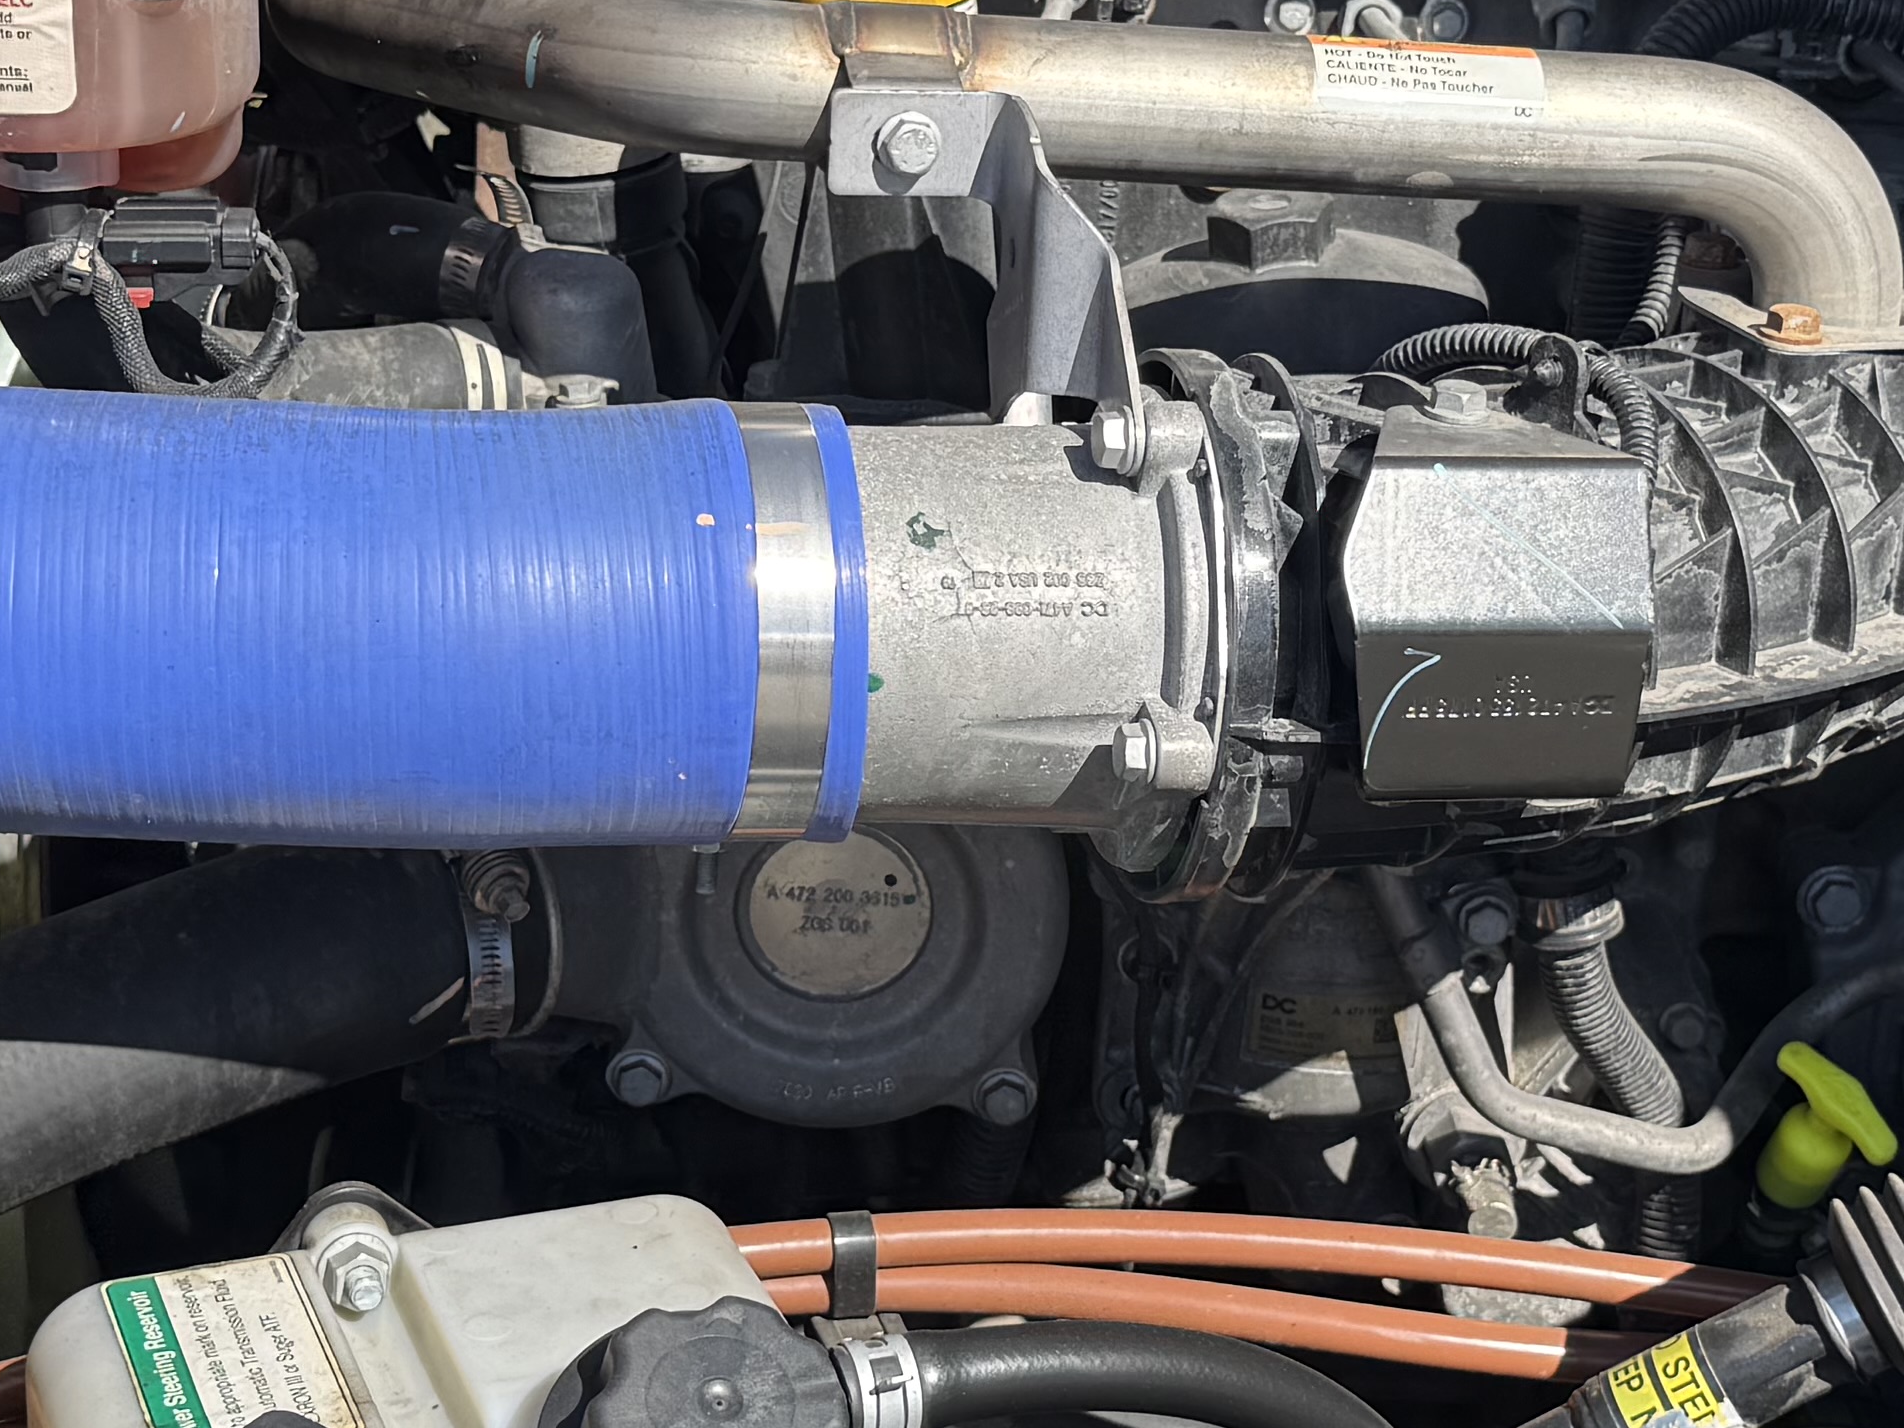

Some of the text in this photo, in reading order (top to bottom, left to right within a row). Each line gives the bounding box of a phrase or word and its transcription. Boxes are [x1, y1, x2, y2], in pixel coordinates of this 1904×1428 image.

[17, 30, 32, 40] or
[1325, 48, 1352, 58] HOT
[1367, 50, 1384, 60] Do
[1416, 54, 1456, 65] Touch
[1326, 59, 1396, 73] CALIENTE
[1410, 65, 1428, 76] No
[1431, 66, 1468, 78] Tocar
[1327, 73, 1378, 87] CHAUD
[1391, 78, 1408, 89] No
[1442, 80, 1494, 95] Toucher
[767, 885, 779, 901] A
[786, 885, 817, 902] 472
[824, 887, 854, 904] 200
[1262, 993, 1297, 1014] DC
[127, 1290, 164, 1350] Reservoir
[194, 1319, 209, 1334] on
[195, 1335, 219, 1358] mark
[208, 1278, 277, 1410] utomatic Transmission Fluid
[152, 1350, 188, 1408] Steering
[207, 1359, 243, 1416] appropriate
